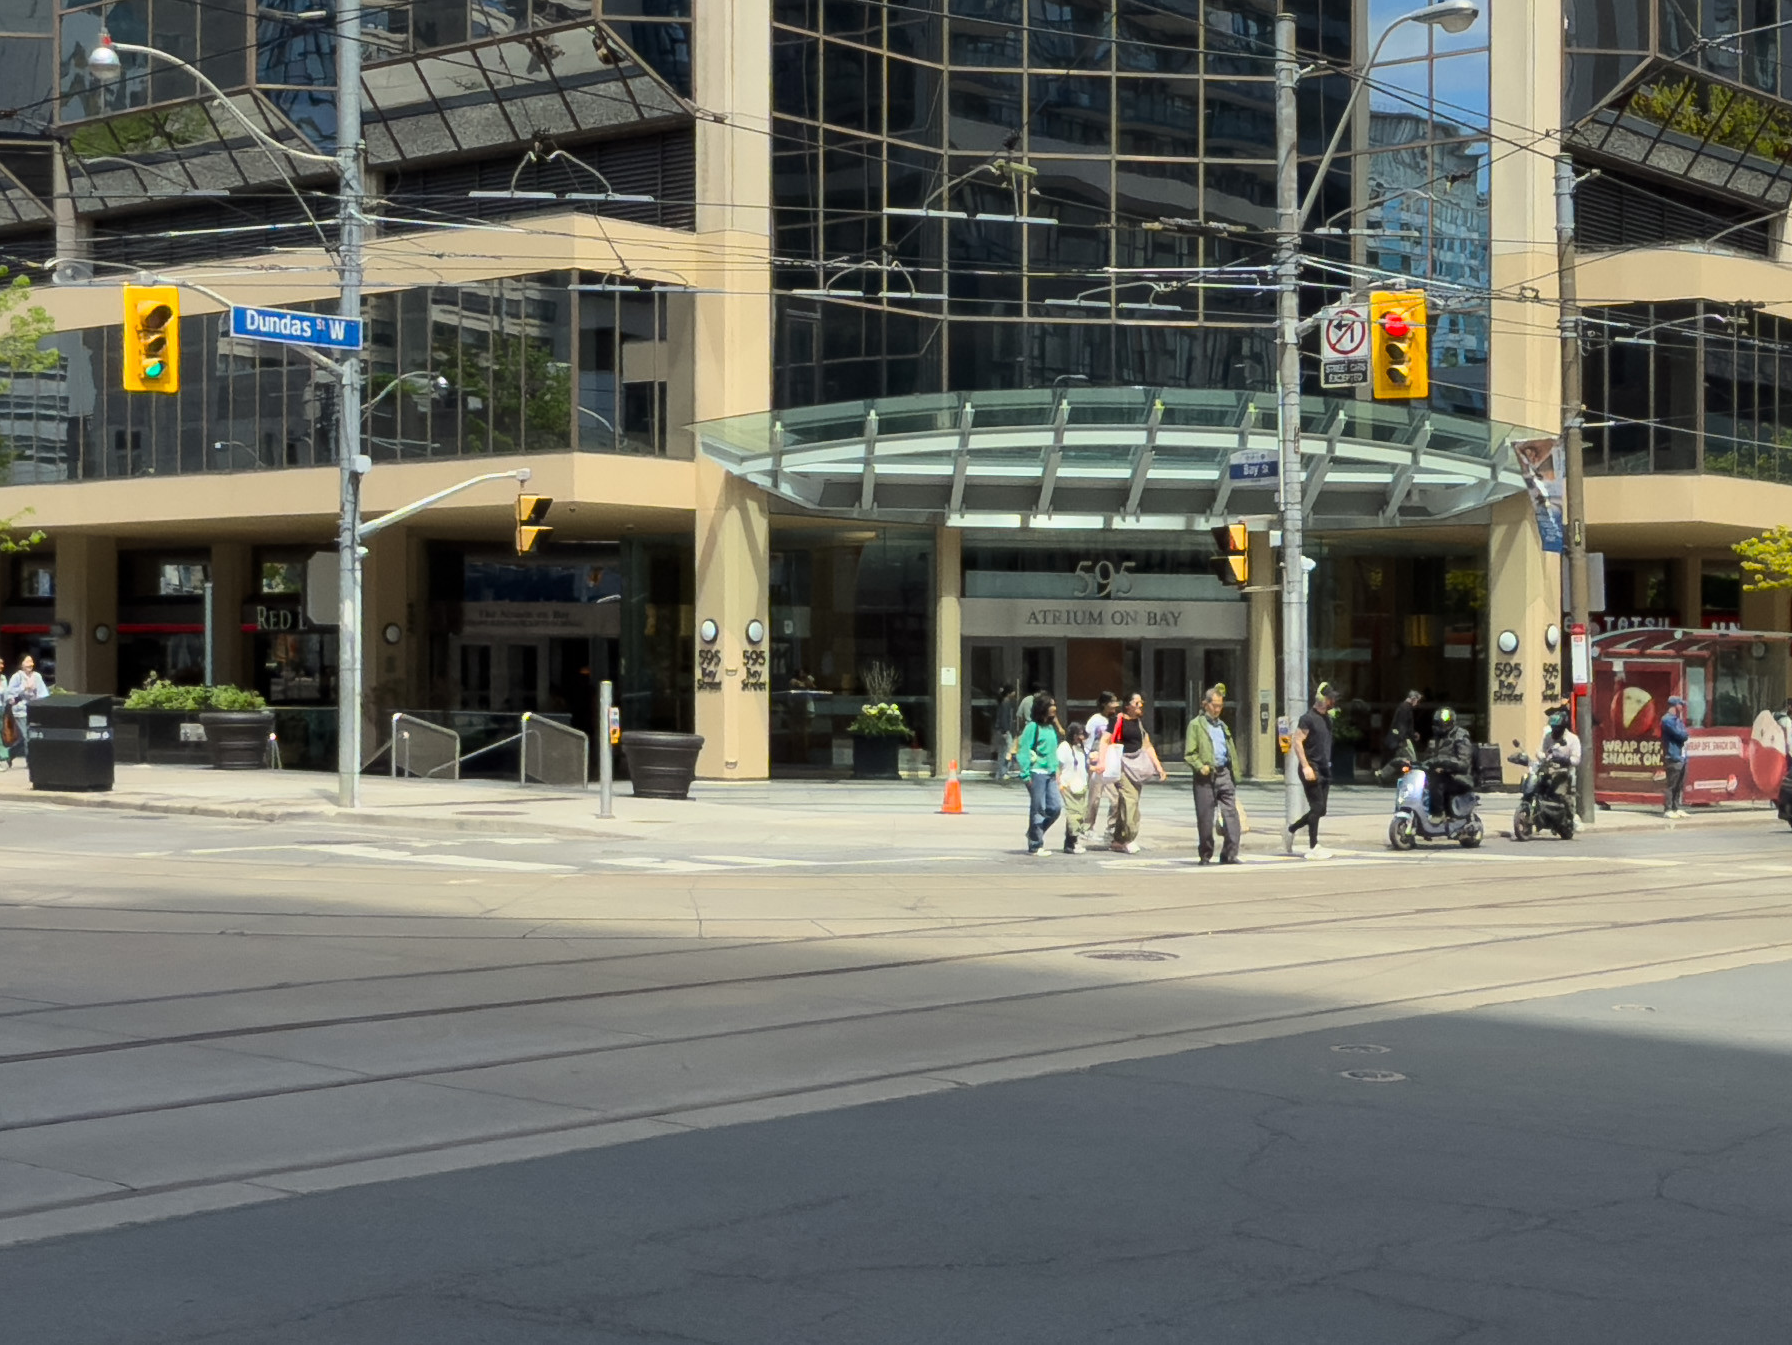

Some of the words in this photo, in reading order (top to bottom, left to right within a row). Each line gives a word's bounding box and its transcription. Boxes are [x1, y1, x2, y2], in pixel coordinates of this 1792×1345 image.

[246, 309, 312, 337] Dundas
[316, 319, 326, 331] St
[328, 319, 345, 341] W
[1243, 463, 1260, 477] Bay
[1073, 561, 1136, 598] 595
[256, 606, 292, 630] RED
[1027, 610, 1103, 625] ATRIUM
[1110, 611, 1137, 626] ON
[1147, 612, 1182, 627] BAY
[699, 649, 721, 667] 595
[743, 650, 766, 667] 595
[1494, 662, 1523, 679] 595
[1602, 739, 1638, 753] WRAP
[1602, 753, 1641, 766] SNACK
[1643, 753, 1664, 766] ON.
